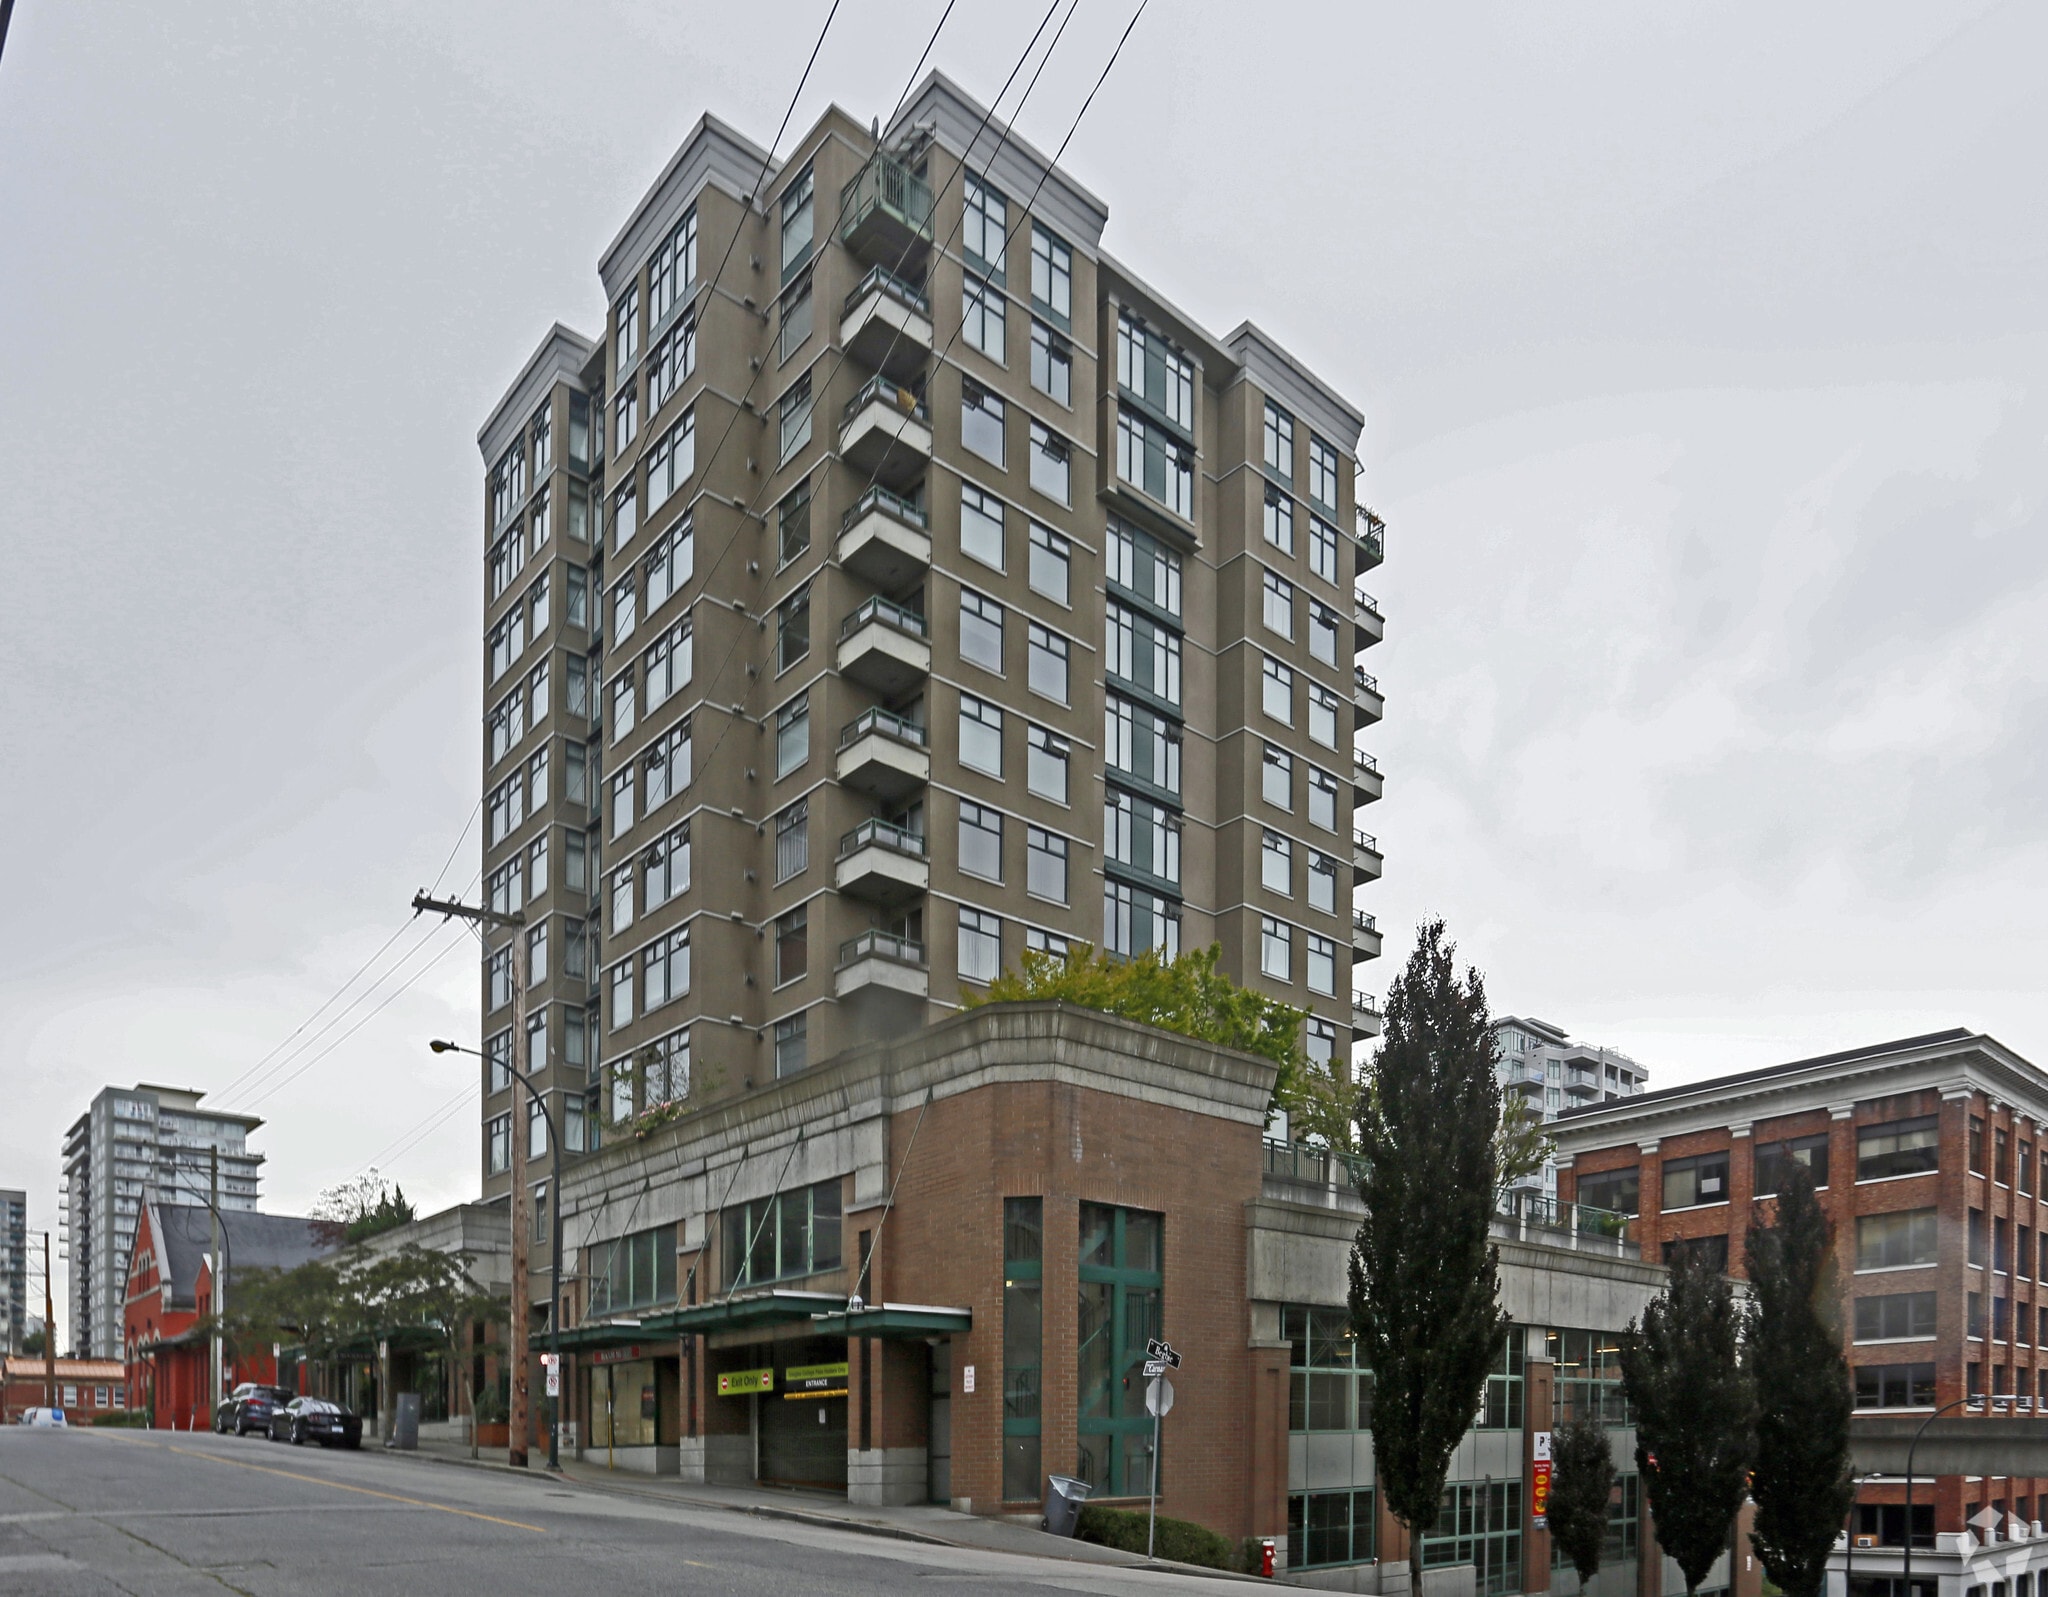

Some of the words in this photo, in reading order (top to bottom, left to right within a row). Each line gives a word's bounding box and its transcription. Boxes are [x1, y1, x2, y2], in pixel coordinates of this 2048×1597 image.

[731, 1376, 742, 1388] Exit
[743, 1374, 758, 1387] Only
[805, 1379, 828, 1387] ENTRANCE
